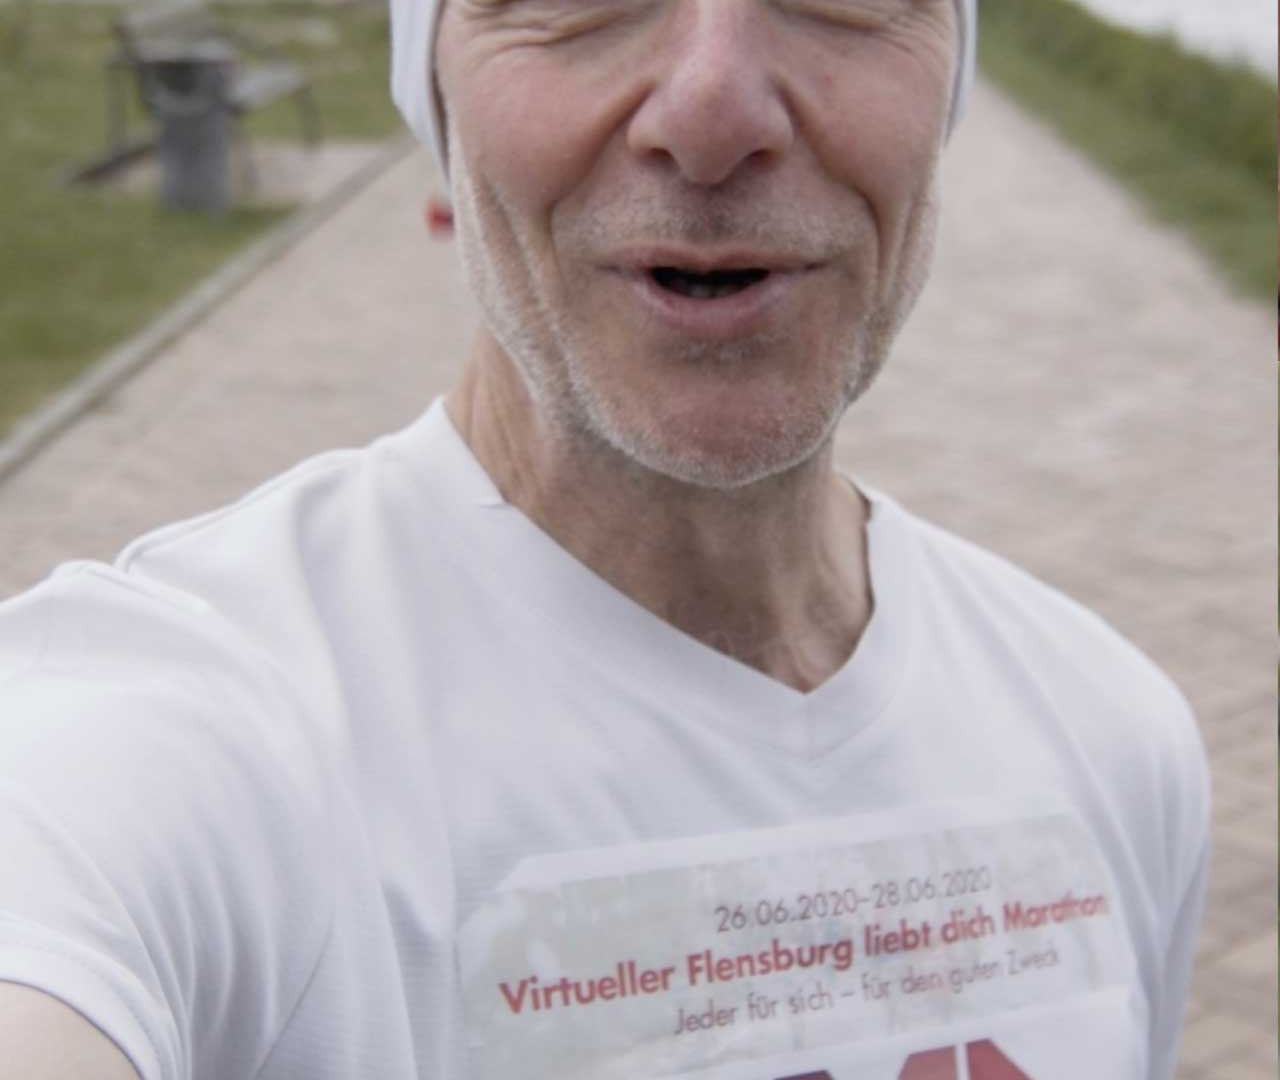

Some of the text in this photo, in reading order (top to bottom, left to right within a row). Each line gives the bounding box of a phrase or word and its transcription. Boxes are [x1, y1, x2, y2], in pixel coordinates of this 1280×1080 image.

[499, 960, 675, 1014] Virtueller
[687, 938, 854, 986] Flensburg
[864, 920, 930, 957] liebt
[940, 906, 995, 944] dich
[674, 999, 738, 1036] Jeder
[748, 991, 777, 1021] für
[789, 980, 834, 1014] sich
[861, 972, 892, 1003] für
[903, 965, 944, 995] den
